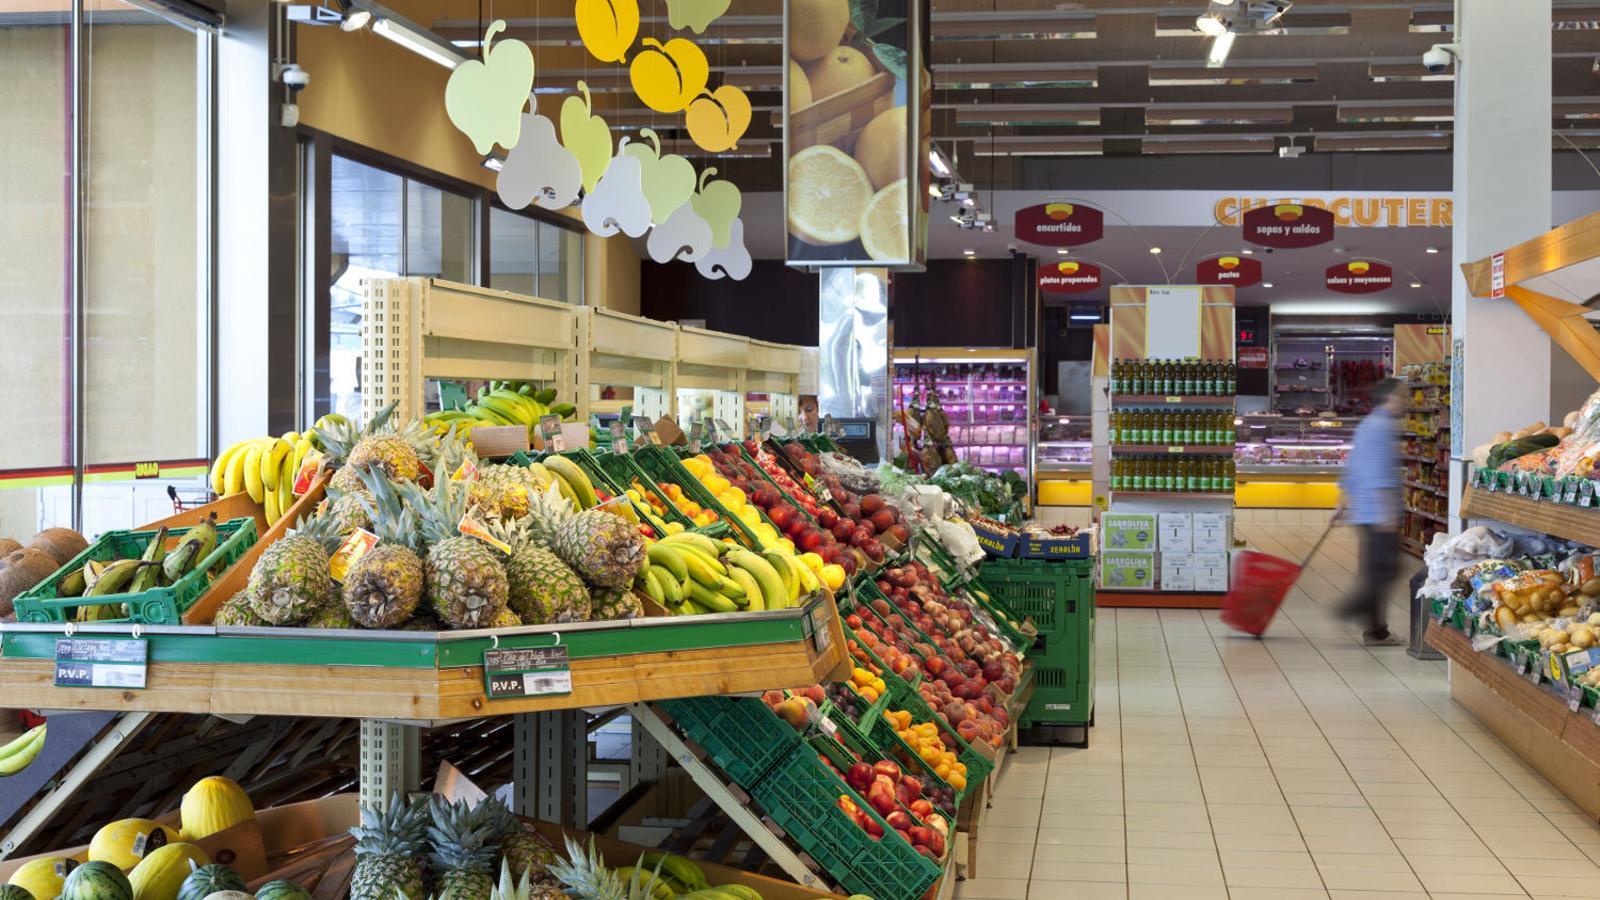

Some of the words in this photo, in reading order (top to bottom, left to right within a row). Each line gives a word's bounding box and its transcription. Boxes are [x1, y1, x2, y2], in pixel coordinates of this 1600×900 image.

[1036, 222, 1082, 233] encurtidos
[1256, 225, 1283, 237] sopas
[1285, 226, 1292, 236] y
[1292, 223, 1321, 235] caldos
[1040, 276, 1060, 286] platos
[1061, 275, 1099, 286] preparados
[1218, 270, 1241, 280] pastas
[1327, 276, 1348, 285] salsas
[1354, 276, 1392, 286] mayonesas
[58, 668, 90, 679] P.V.P.
[492, 680, 521, 691] P.V.P.
